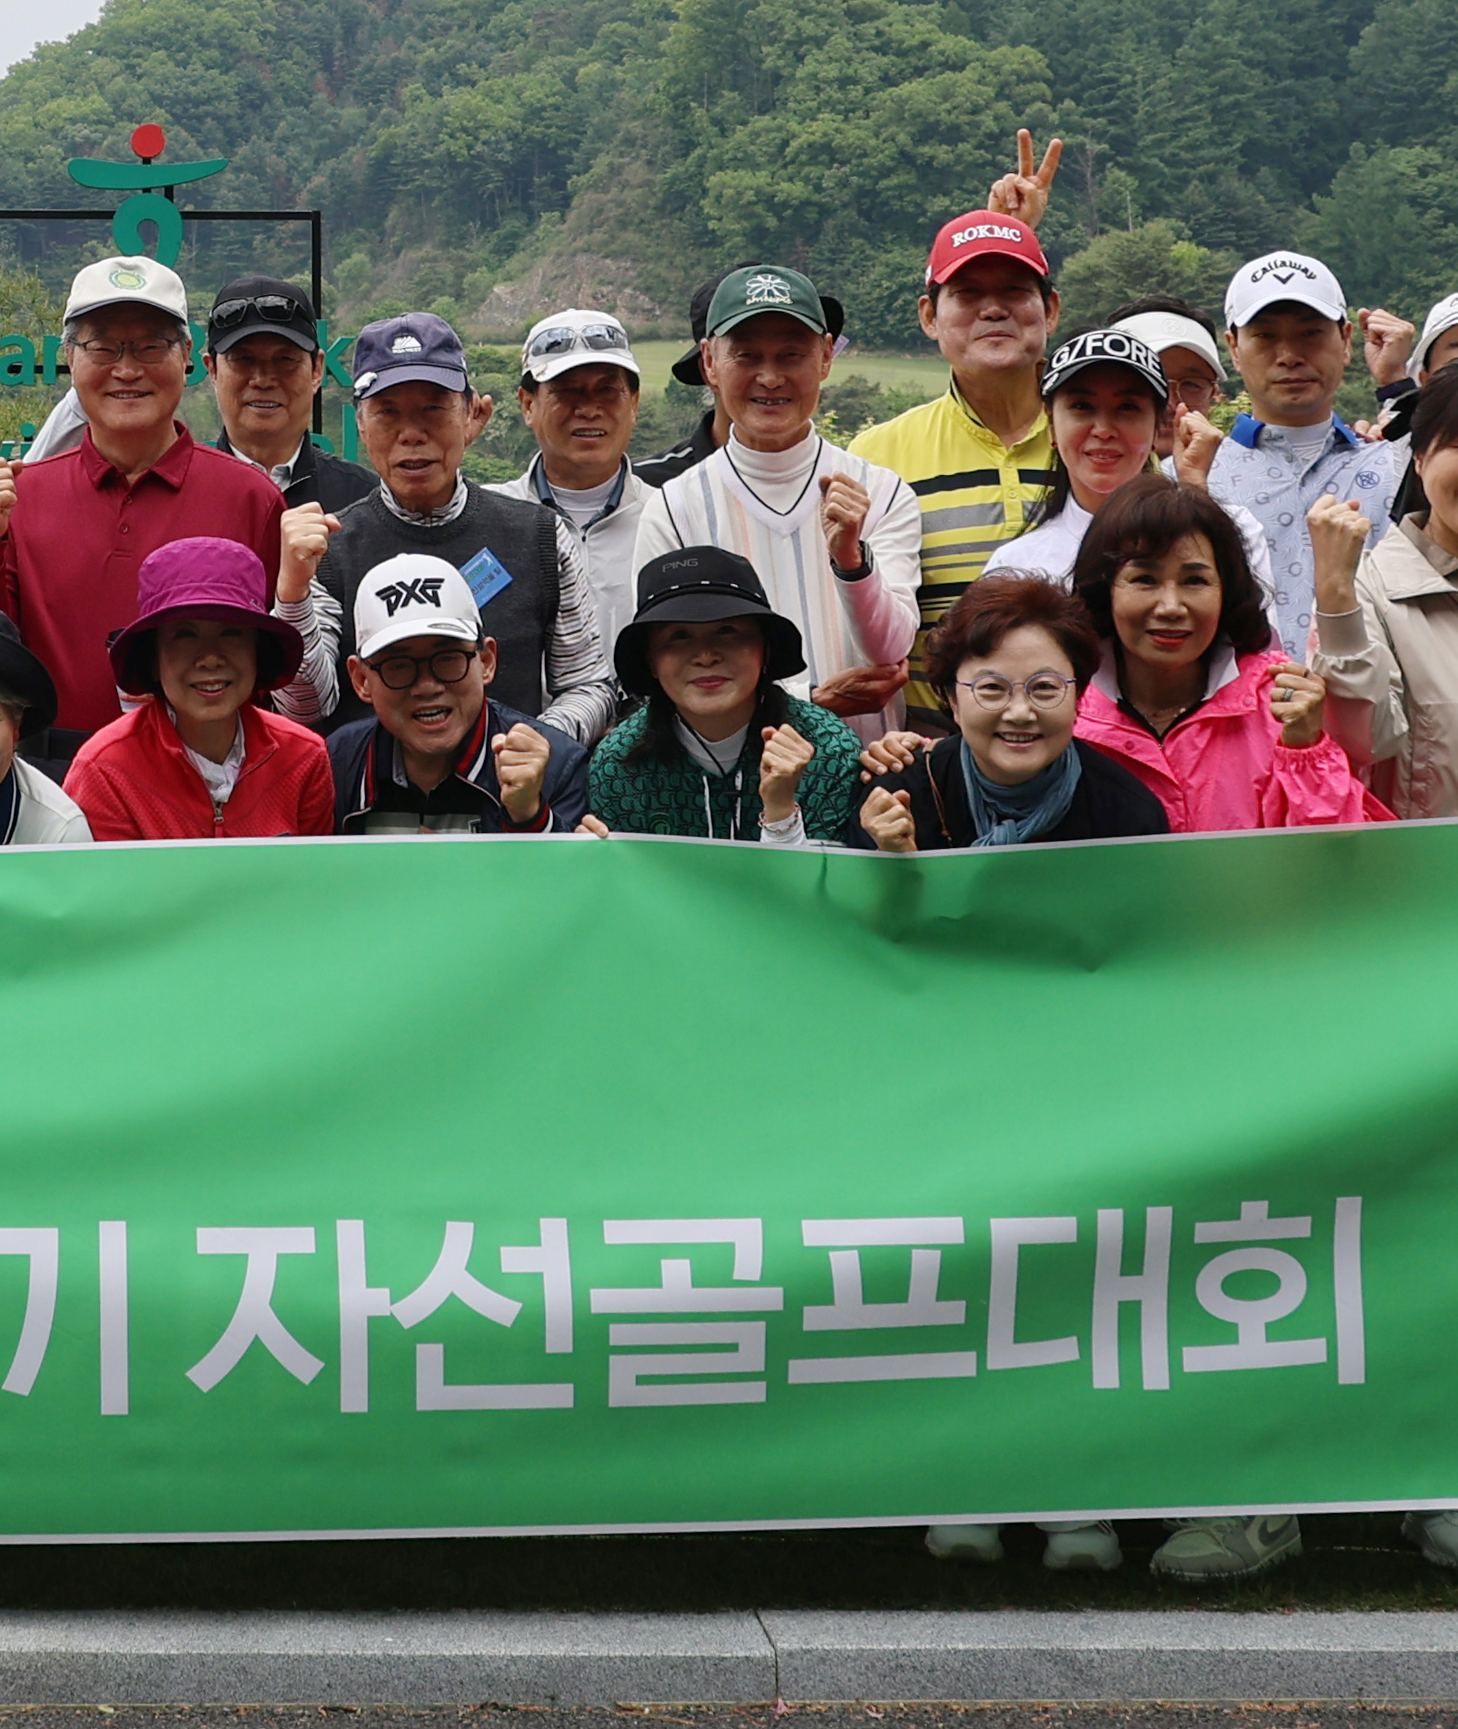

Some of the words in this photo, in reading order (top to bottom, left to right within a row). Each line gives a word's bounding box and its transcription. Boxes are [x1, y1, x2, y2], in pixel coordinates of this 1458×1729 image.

[951, 225, 1022, 247] ROKMC
[1251, 259, 1317, 283] Callaway
[1051, 333, 1163, 378] G/FORE
[662, 557, 699, 573] PING
[375, 577, 445, 618] PXG
[186, 1197, 1365, 1413] 자선골프대회
